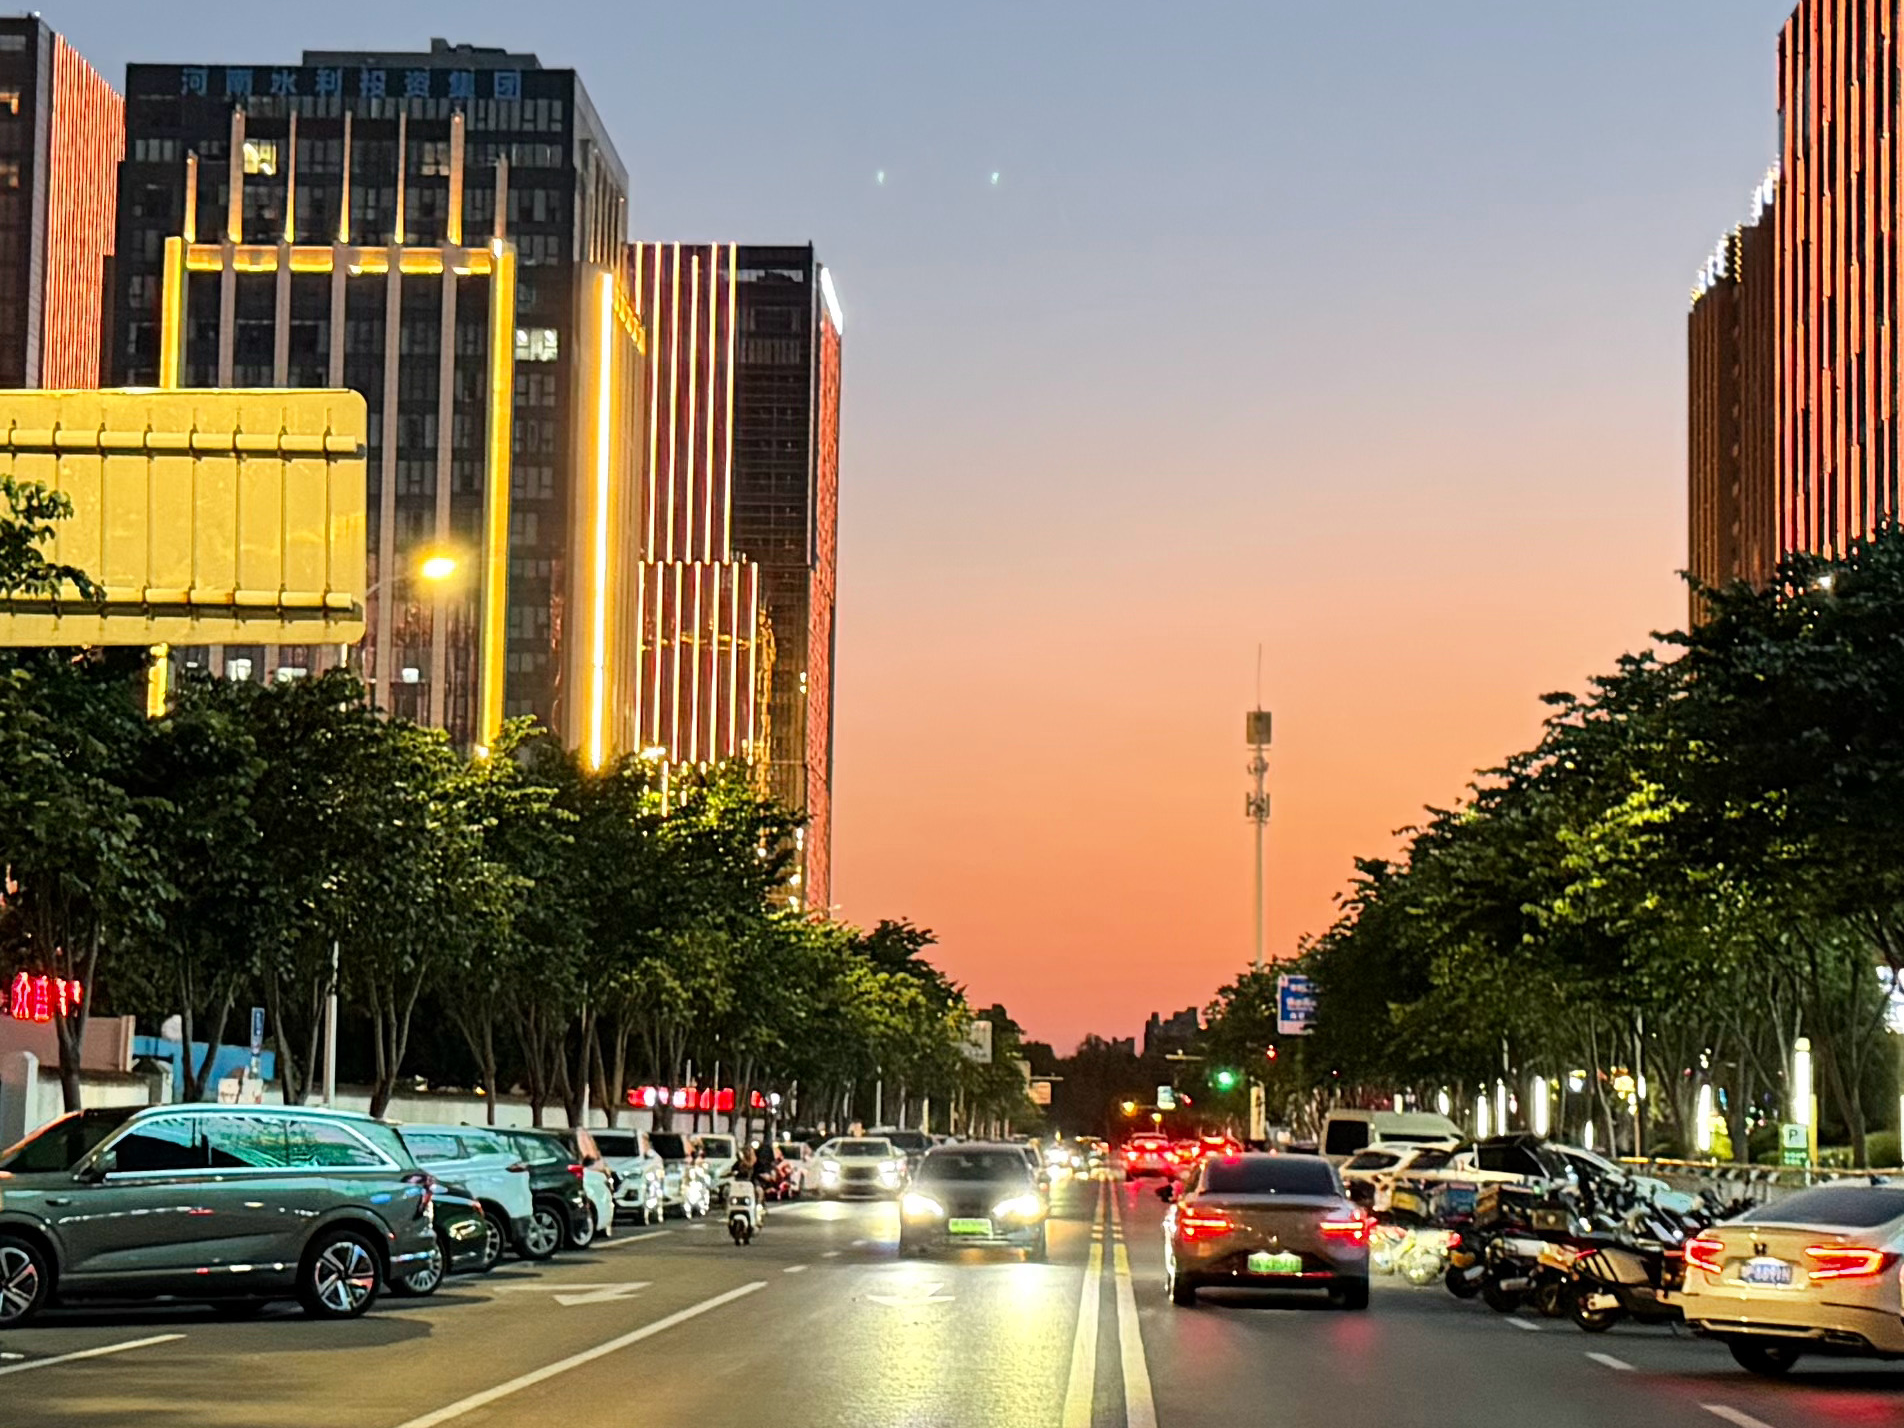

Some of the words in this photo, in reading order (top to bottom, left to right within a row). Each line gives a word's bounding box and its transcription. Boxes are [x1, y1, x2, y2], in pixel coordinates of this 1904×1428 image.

[180, 67, 523, 102] 河南水利投资集团
